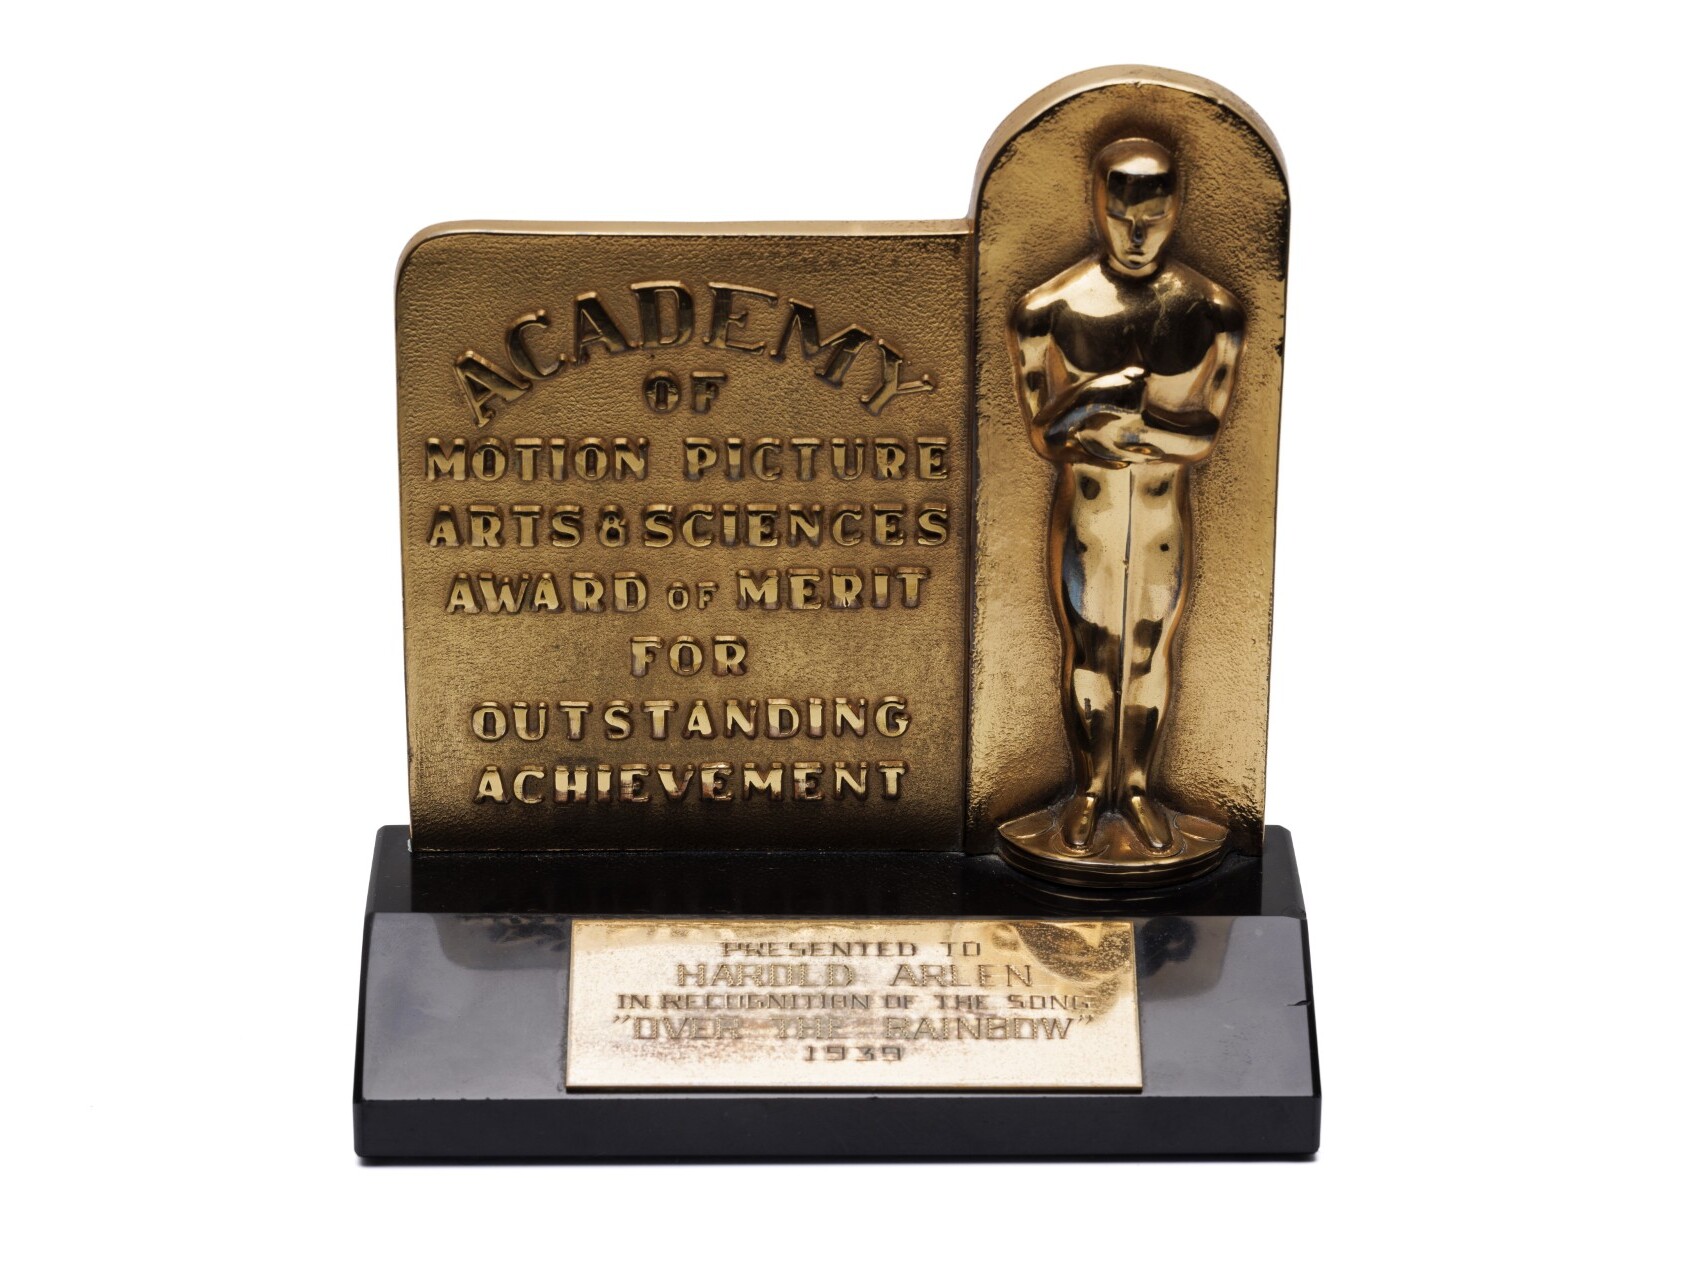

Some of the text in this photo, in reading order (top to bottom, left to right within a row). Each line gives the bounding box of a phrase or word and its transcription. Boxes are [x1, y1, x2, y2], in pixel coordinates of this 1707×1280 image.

[453, 280, 938, 428] ACADEMY
[644, 370, 727, 414] OF
[425, 436, 951, 482] MOTION PICTURE
[428, 504, 585, 548] ARTS
[643, 503, 951, 548] SCIENCES
[446, 567, 931, 615] AWARD OF MERIT
[630, 635, 749, 677] FOR
[471, 696, 911, 741] OUTSTANDING
[473, 761, 911, 805] ACHIEVEMENT
[722, 941, 981, 957] PRESENTED TO
[676, 963, 1032, 988] HAROLD ARLEN
[617, 994, 1097, 1010] IN RECOGNITION OF THE SONG
[770, 1016, 850, 1040] THE
[804, 1045, 905, 1062] 1939
